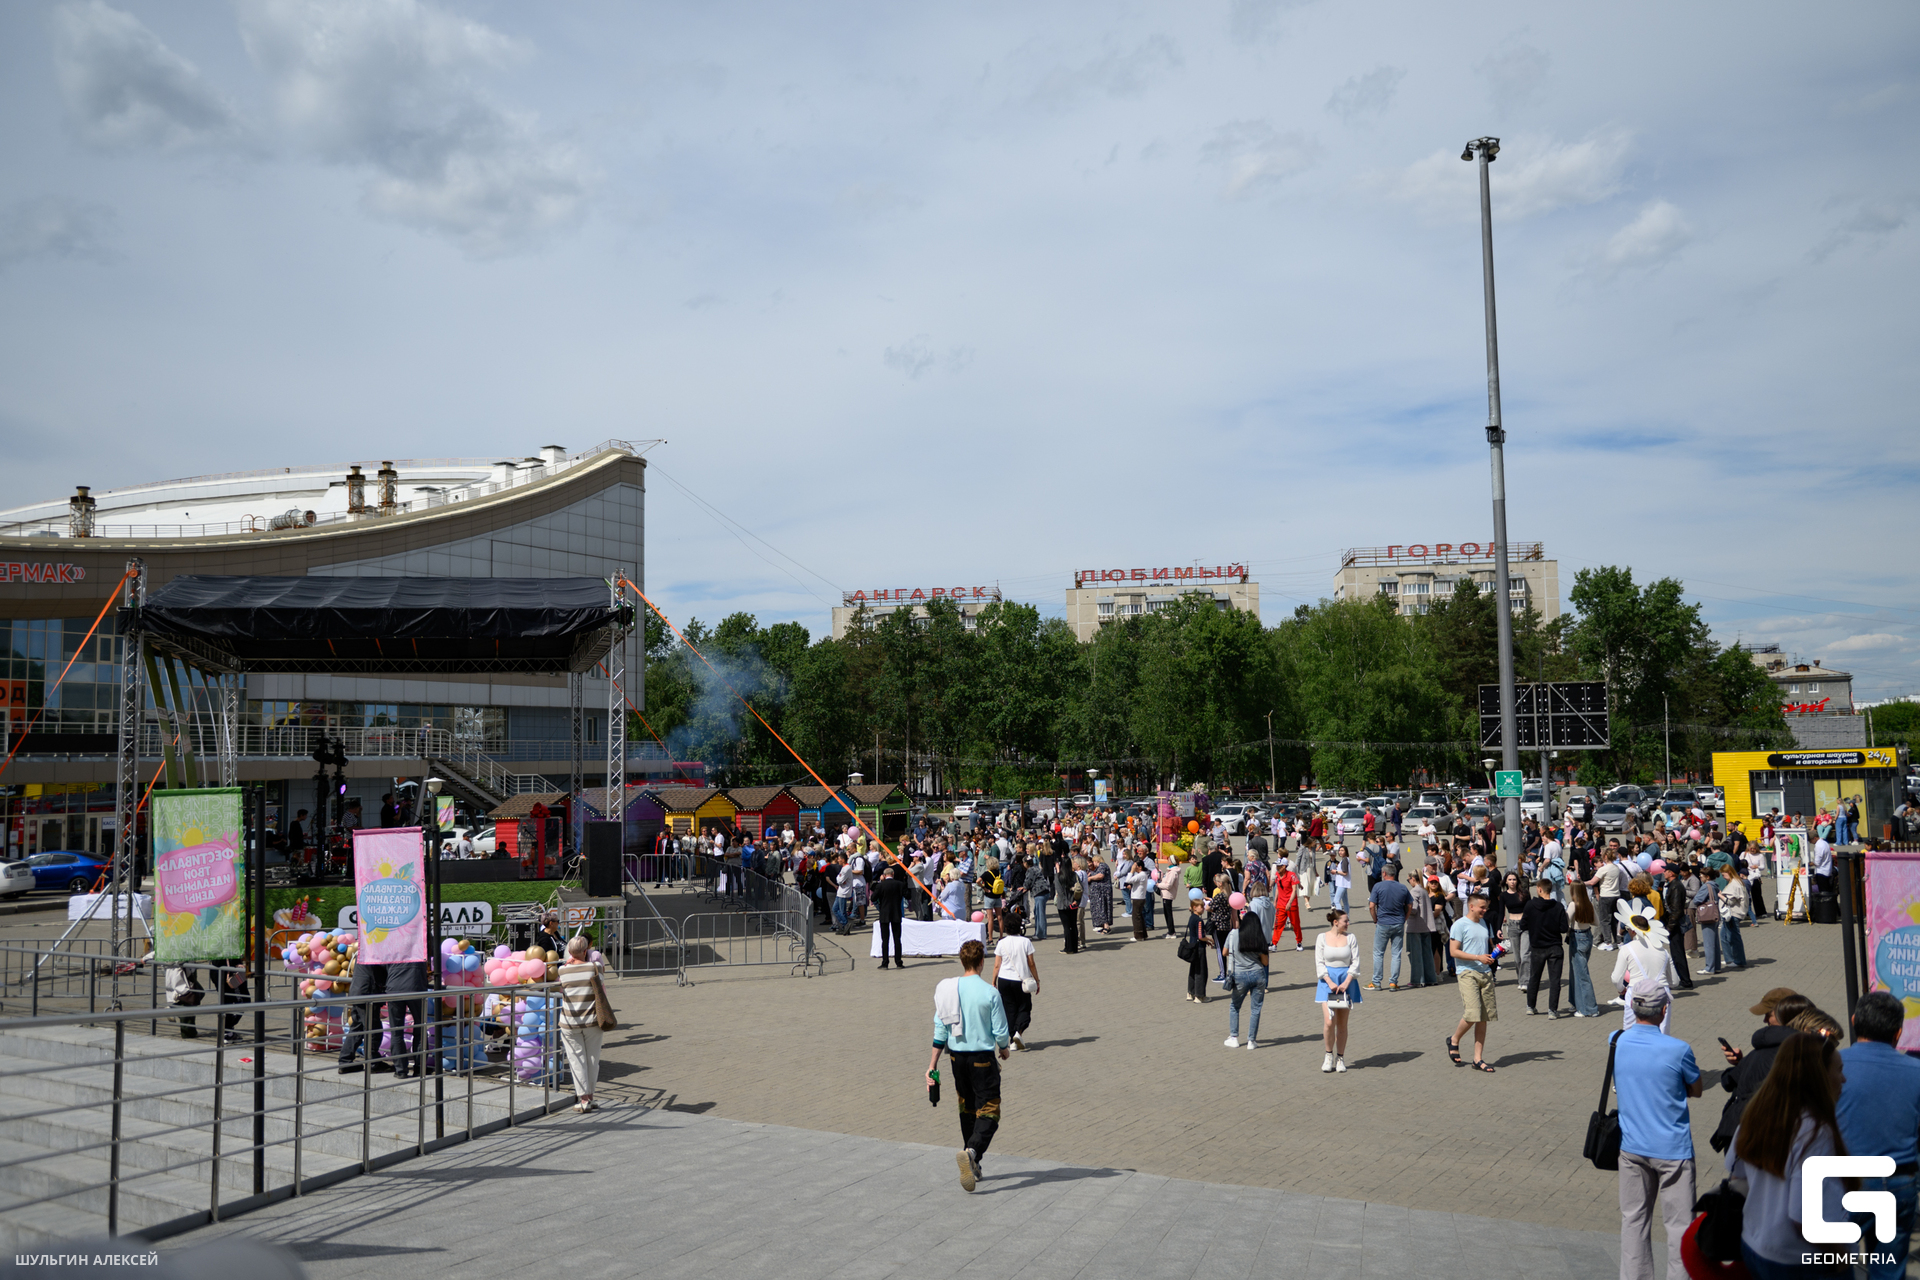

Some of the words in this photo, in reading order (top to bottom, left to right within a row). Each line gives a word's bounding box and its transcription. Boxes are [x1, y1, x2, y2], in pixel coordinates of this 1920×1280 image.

[1081, 562, 1244, 582] ЛЮБИМЫЙ
[852, 586, 986, 600] АНГАРСК
[1782, 752, 1825, 760] культурная
[1826, 751, 1858, 759] шаурма
